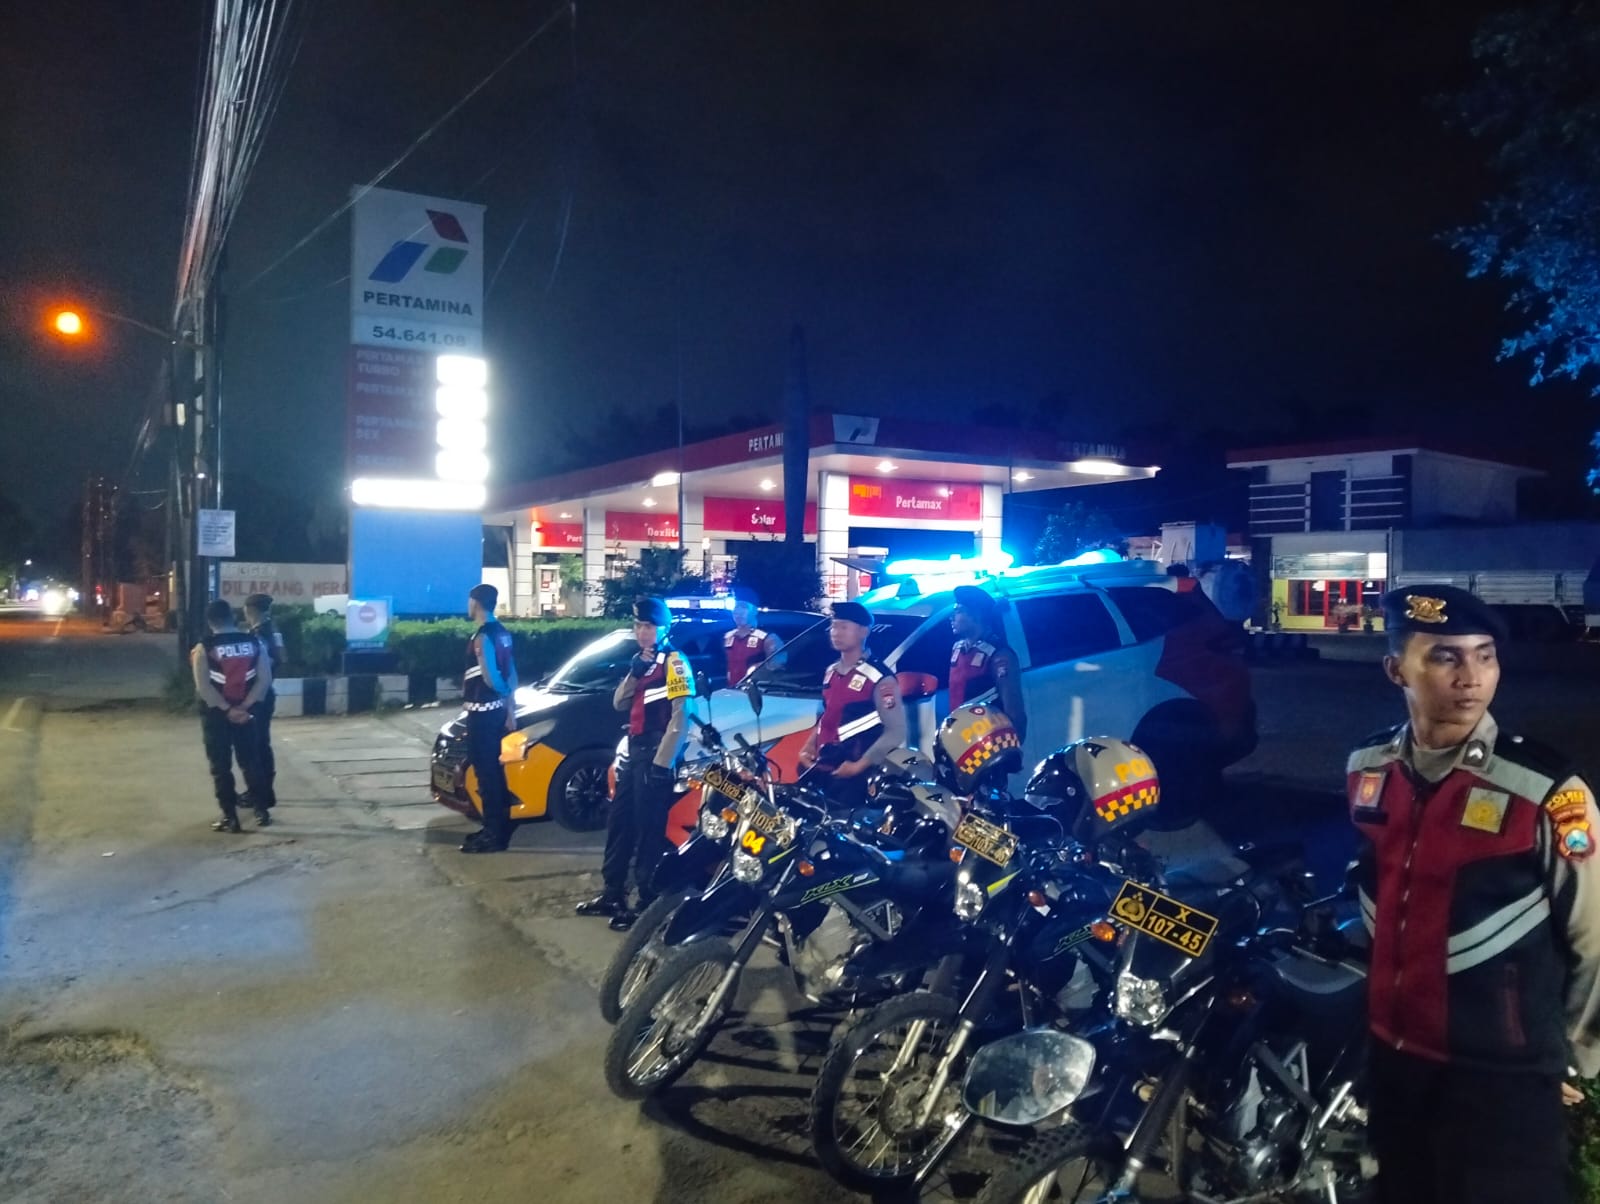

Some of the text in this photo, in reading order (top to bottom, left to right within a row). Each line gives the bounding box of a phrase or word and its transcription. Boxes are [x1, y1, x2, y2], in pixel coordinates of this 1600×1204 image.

[363, 291, 473, 316] PERTAMINA
[896, 496, 942, 510] Pertamax
[751, 513, 776, 525] Solar
[222, 580, 304, 597] DILARANG
[742, 830, 766, 855] 04
[1176, 907, 1191, 923] X
[1147, 915, 1203, 951] 107-45
